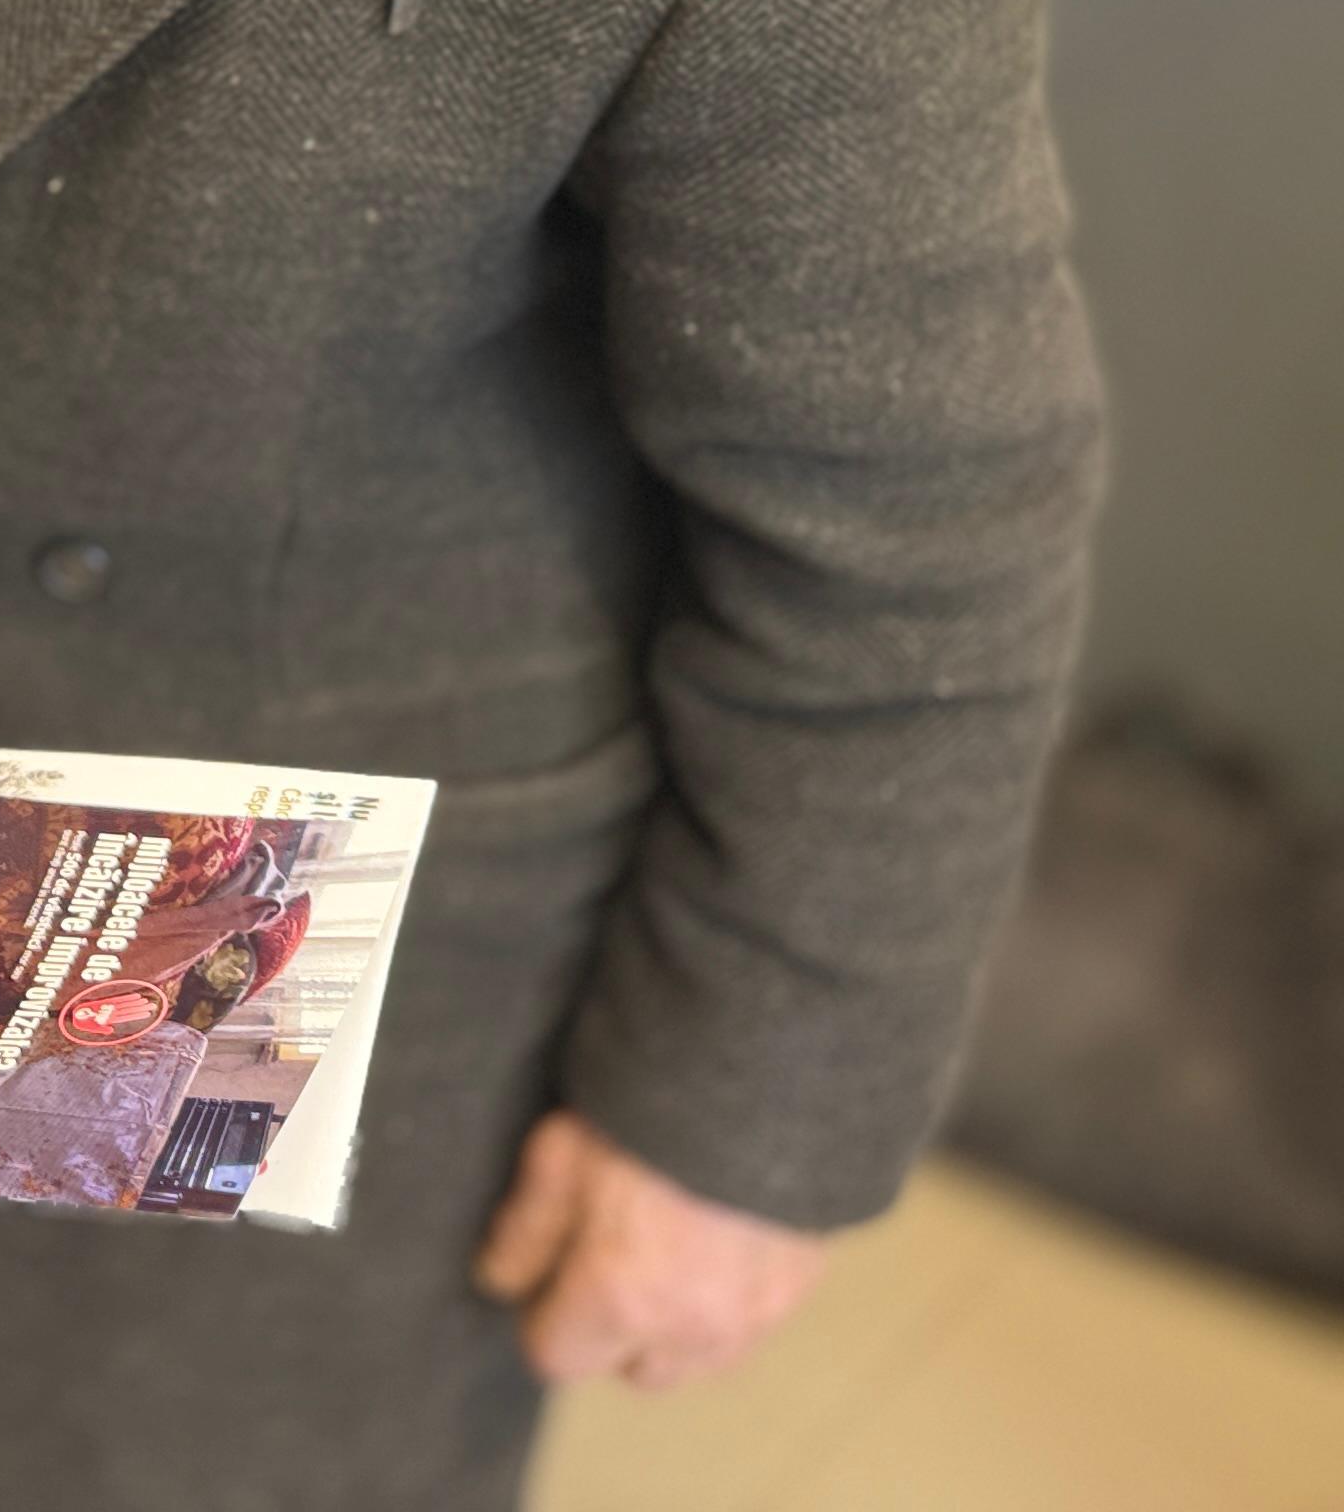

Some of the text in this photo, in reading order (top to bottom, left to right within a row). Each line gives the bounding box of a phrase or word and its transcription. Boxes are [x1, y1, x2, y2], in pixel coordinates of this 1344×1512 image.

[349, 796, 379, 821] Nu
[59, 852, 83, 880] 500
[52, 878, 71, 897] de
[60, 832, 138, 933] încălzire
[81, 836, 172, 982] mijloacele de
